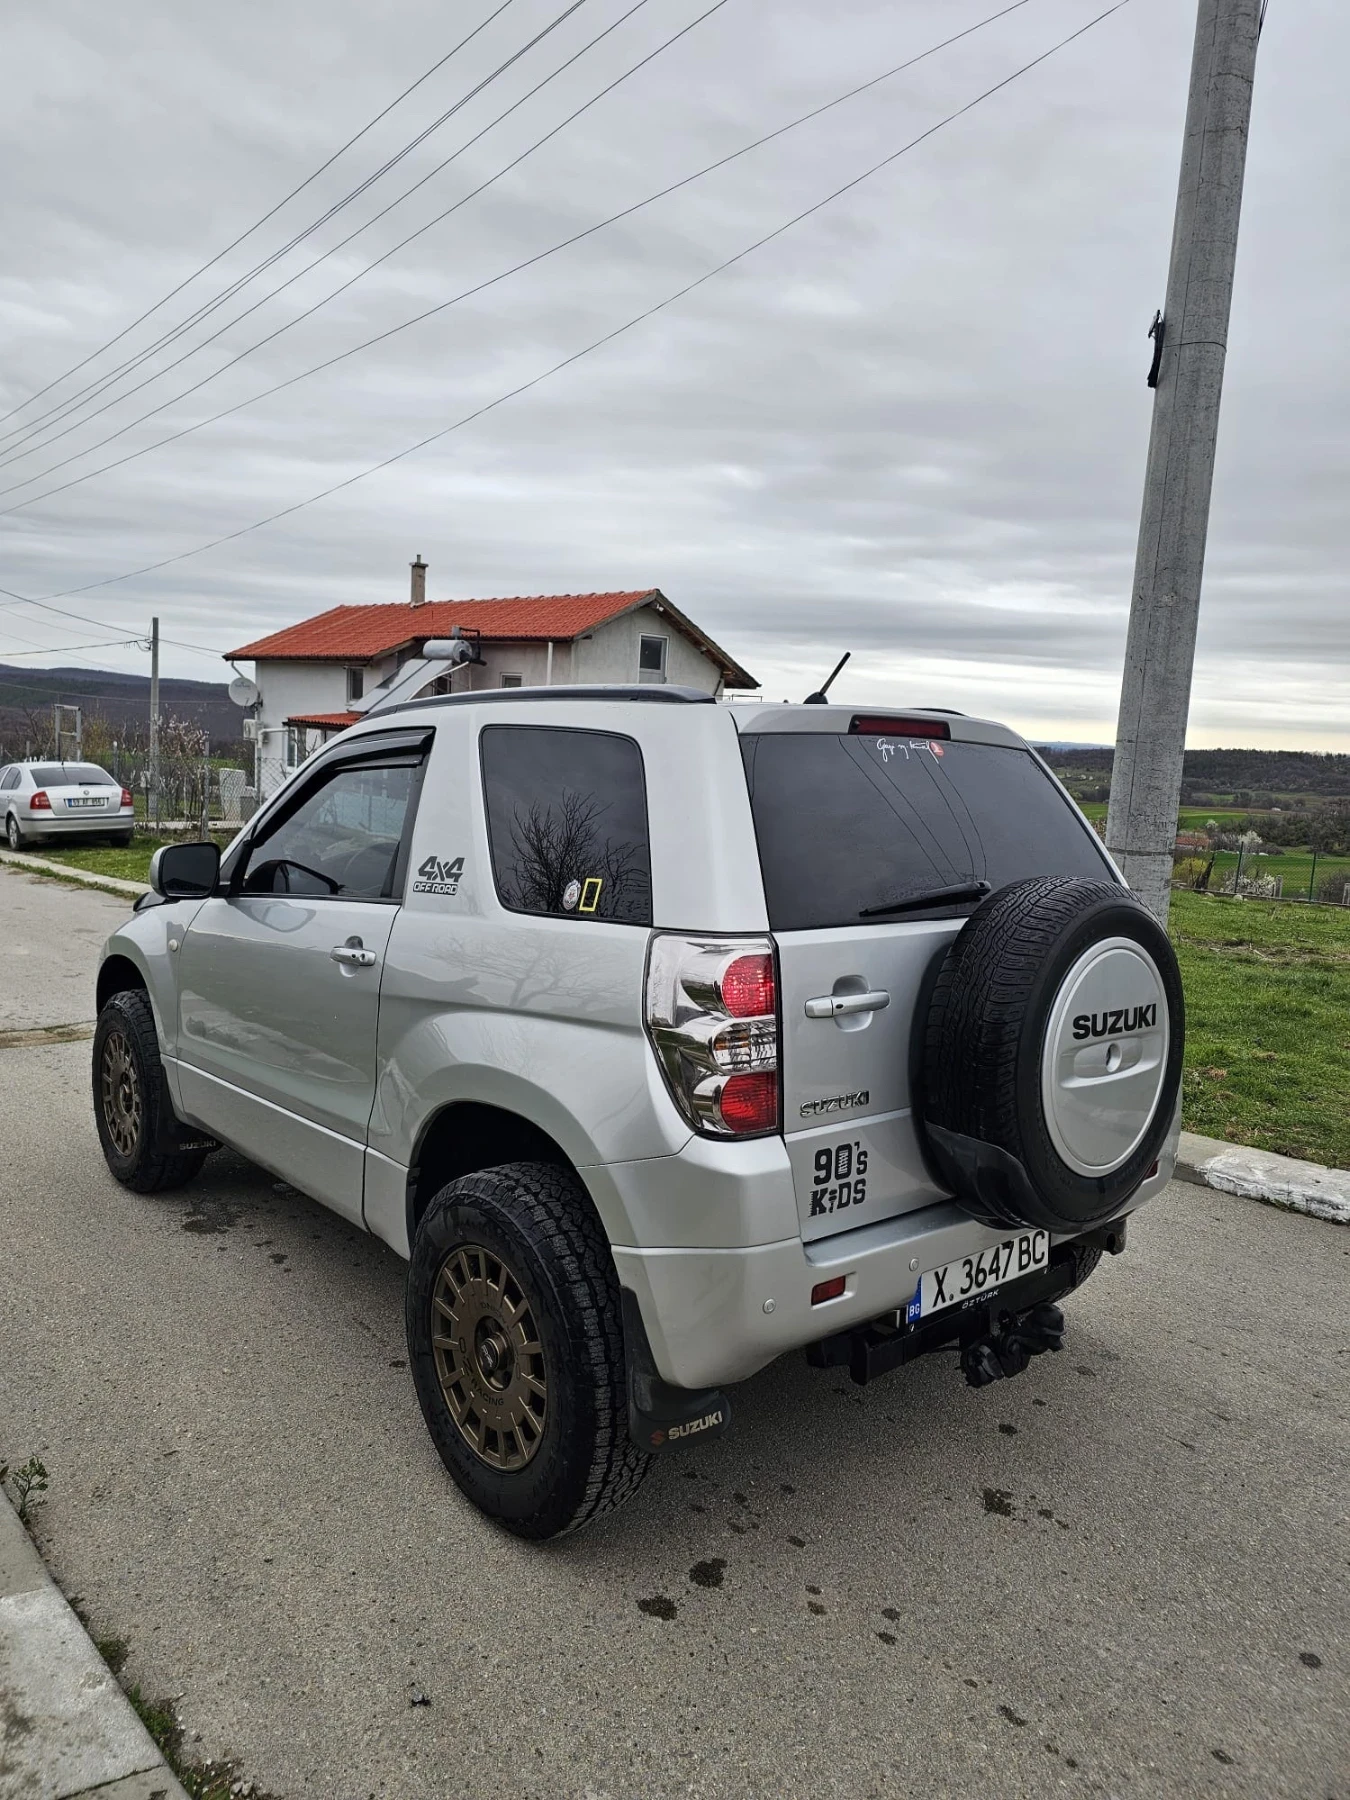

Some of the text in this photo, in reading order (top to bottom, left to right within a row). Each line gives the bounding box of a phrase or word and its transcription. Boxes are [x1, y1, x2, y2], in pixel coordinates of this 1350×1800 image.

[413, 882, 458, 895] OFF ROAD
[1072, 1003, 1157, 1040] SUZUKI
[800, 1090, 869, 1118] SUZUKI
[909, 1303, 920, 1317] BG
[668, 1410, 723, 1440] SUZUKI
